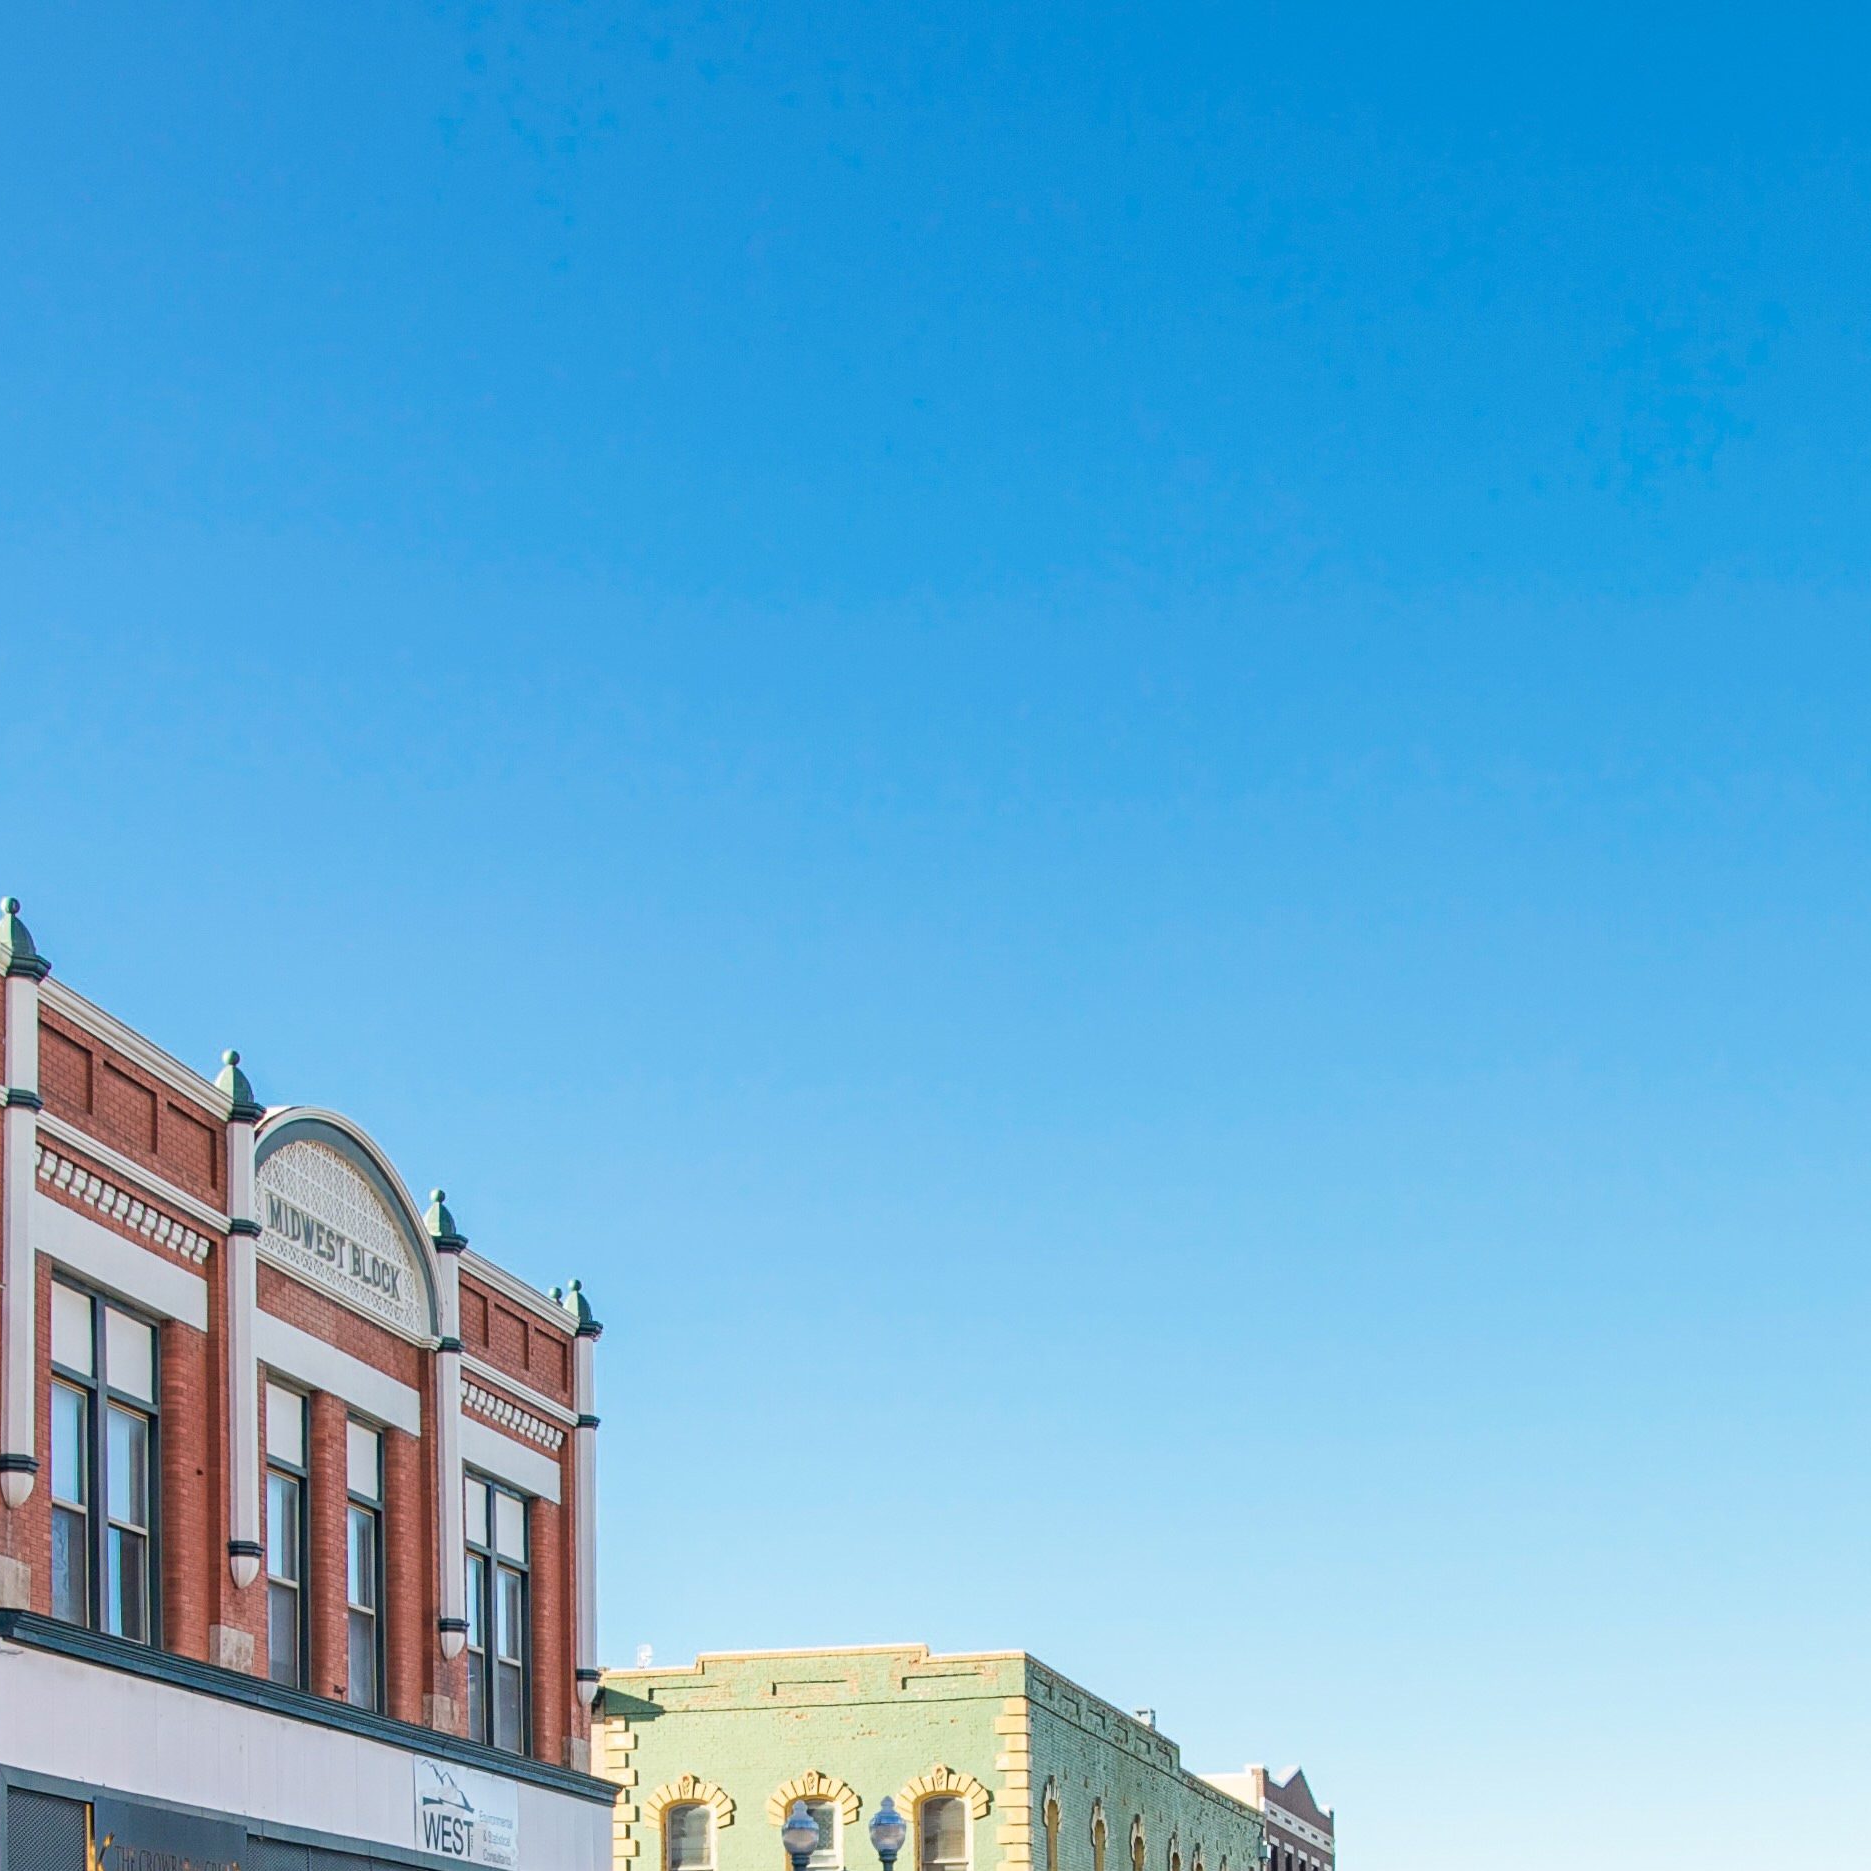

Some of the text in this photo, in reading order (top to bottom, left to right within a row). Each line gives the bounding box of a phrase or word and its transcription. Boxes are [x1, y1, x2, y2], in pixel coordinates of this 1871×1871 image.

[265, 1193, 401, 1301] MIDWEST BLOCK
[423, 1811, 474, 1857] WEST
